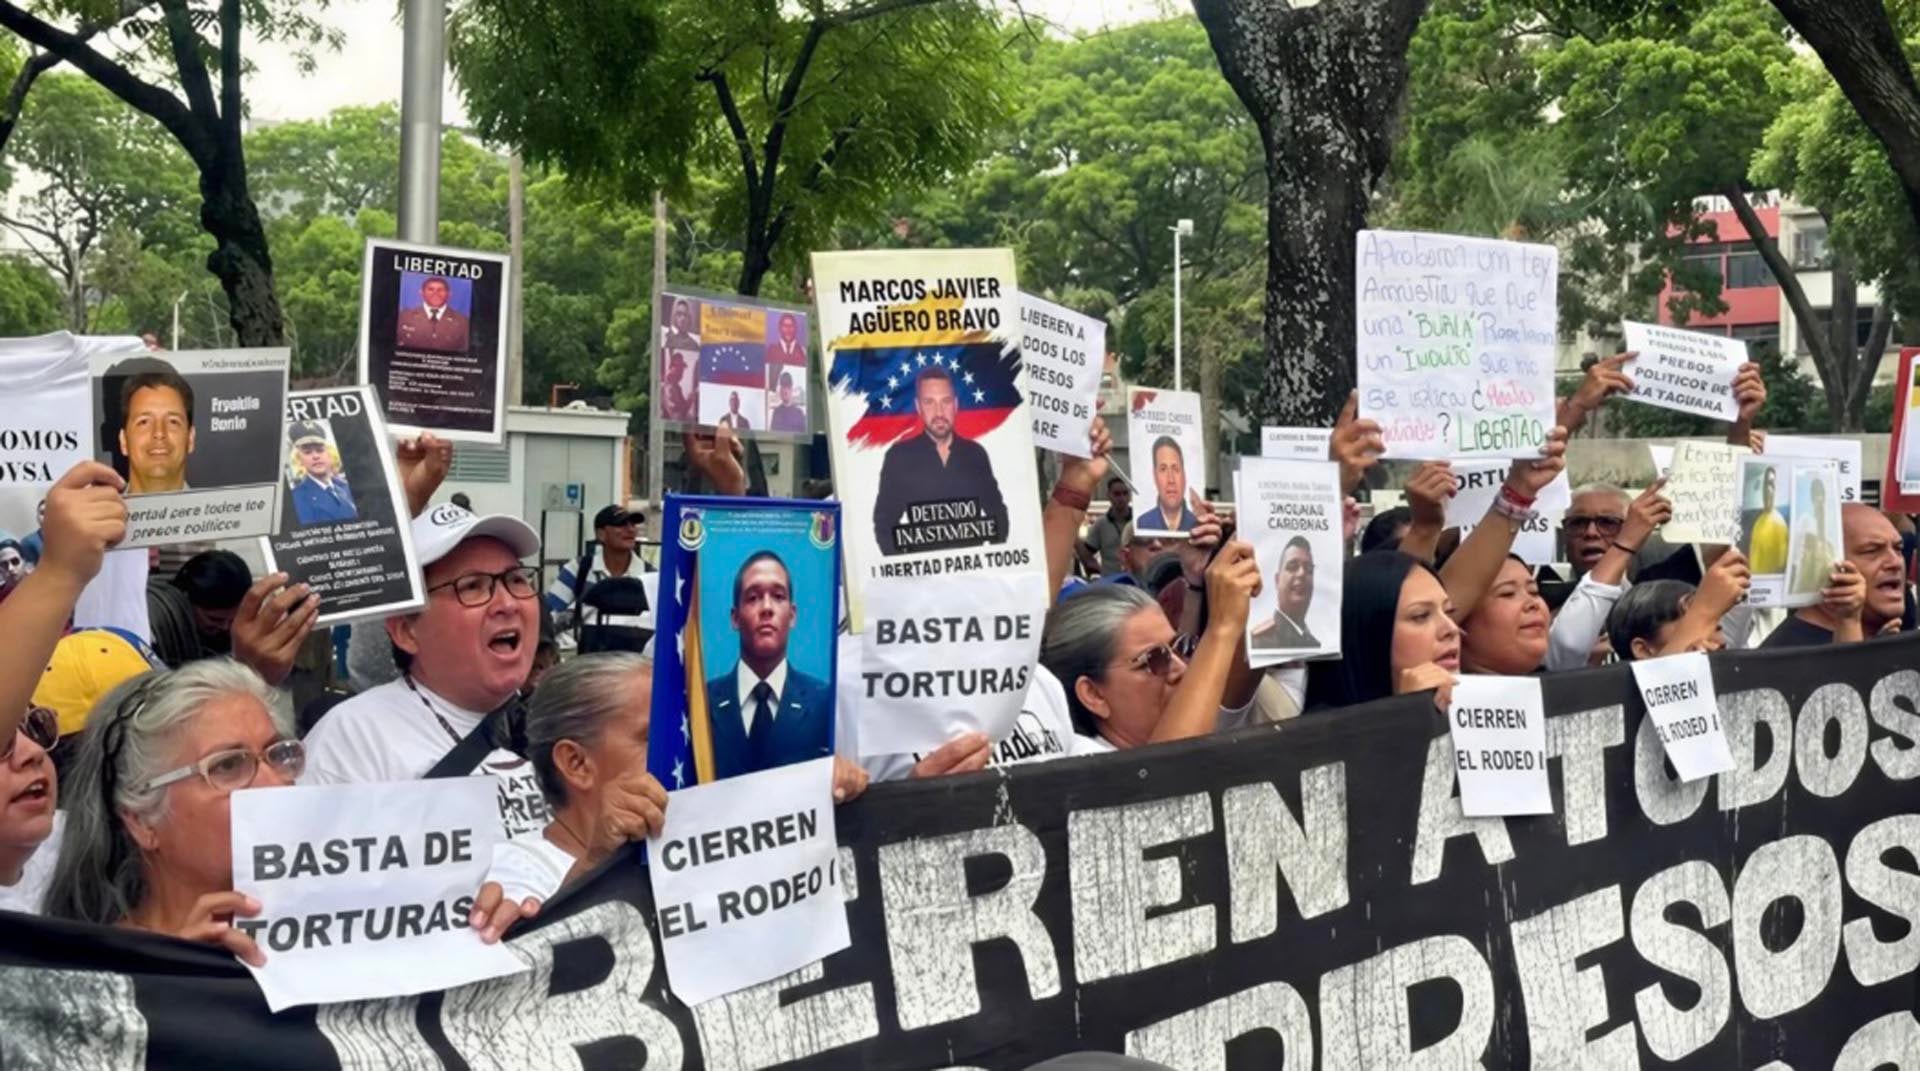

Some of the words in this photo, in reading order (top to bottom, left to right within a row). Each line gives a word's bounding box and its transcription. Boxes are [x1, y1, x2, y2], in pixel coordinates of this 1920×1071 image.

[393, 254, 483, 280] LIBERTAD
[840, 280, 926, 303] MARCOS
[931, 278, 1001, 300] JAVIER
[849, 306, 930, 334] AGÜERO
[937, 308, 1000, 331] BRAVO
[1020, 307, 1075, 337] LIBEREN
[1062, 347, 1086, 367] LOS
[1072, 404, 1089, 420] DE
[0, 430, 78, 451] OMOS
[946, 553, 982, 573] PARA
[876, 617, 984, 645] BASTA
[994, 615, 1031, 641] DE
[862, 665, 1028, 699] TORTURAS
[1456, 708, 1527, 729] CIERREN
[1457, 750, 1477, 771] EL
[1481, 750, 1534, 771] RODEO
[661, 808, 817, 872] CIERREN
[252, 835, 409, 881] BASTA
[424, 828, 472, 866] DE
[659, 902, 707, 939] EL
[717, 865, 822, 924] RODEO
[236, 895, 475, 952] TORTURAS
